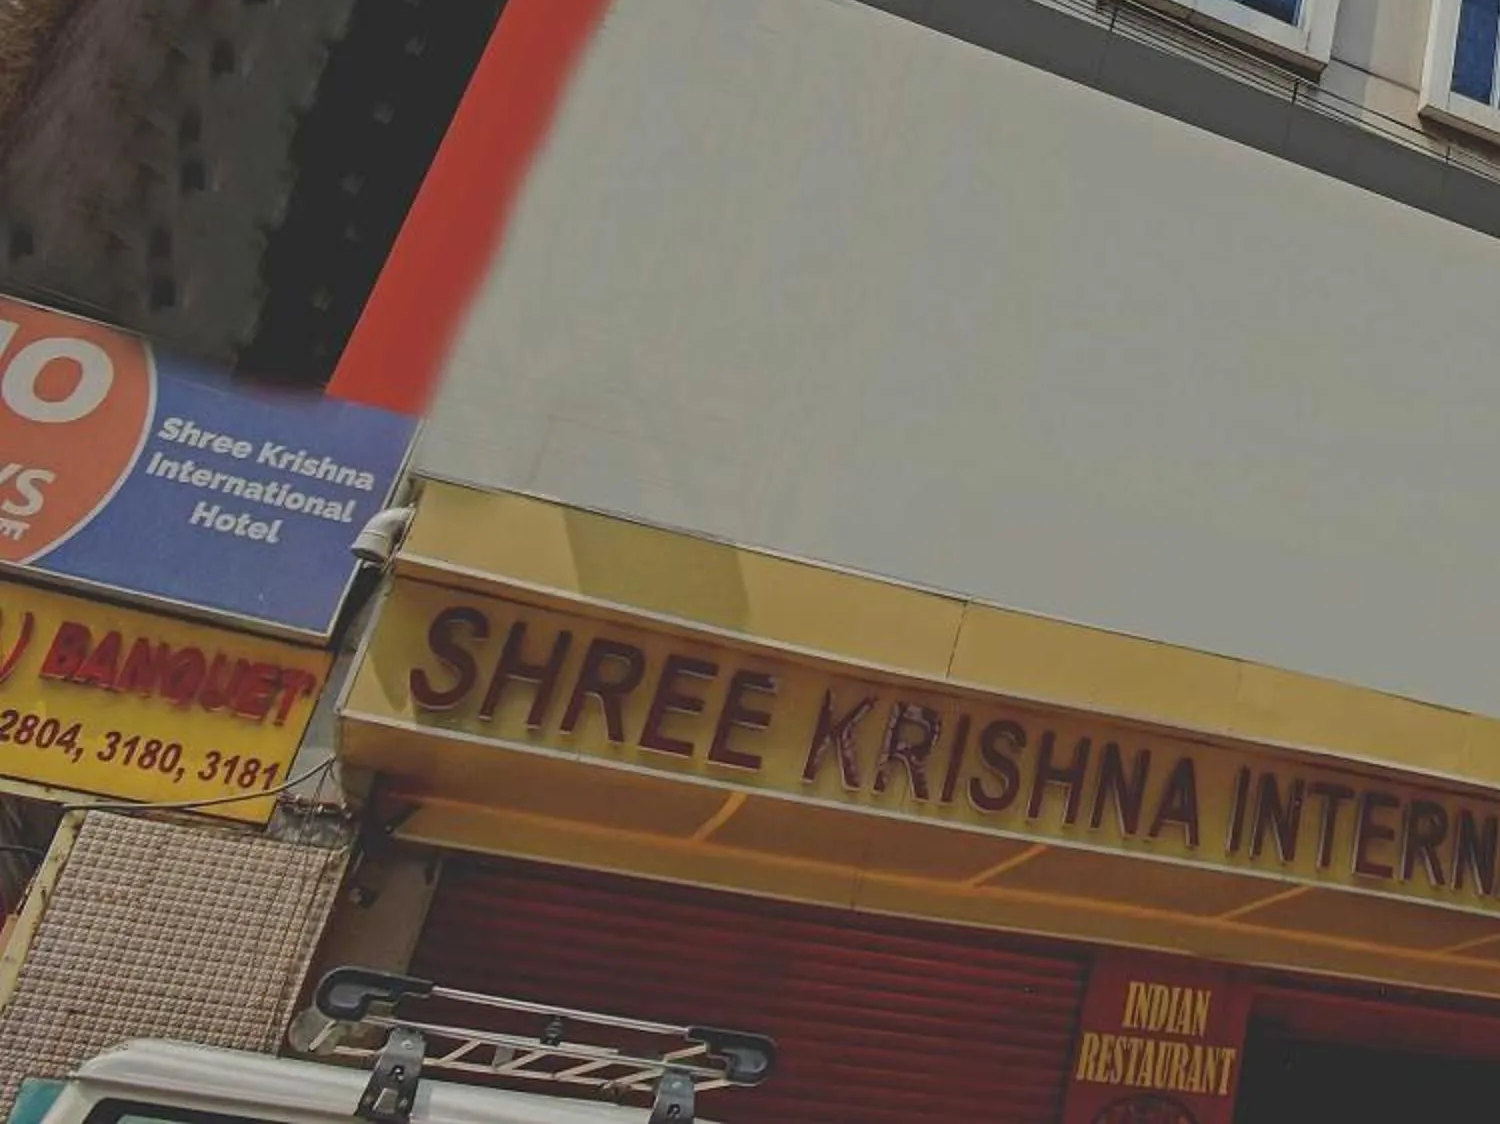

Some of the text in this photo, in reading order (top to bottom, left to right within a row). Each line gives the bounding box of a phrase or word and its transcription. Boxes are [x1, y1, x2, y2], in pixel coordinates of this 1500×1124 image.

[146, 452, 356, 523] International
[158, 417, 376, 491] Shree Krishna
[189, 501, 284, 543] Hotel
[39, 621, 317, 727] BANQUET
[97, 731, 184, 783] 3180,
[198, 751, 281, 790] 3181
[409, 605, 778, 771] SHREE
[801, 687, 1202, 851] KRISHNA
[1122, 981, 1212, 1037] INDIAN
[1075, 1031, 1238, 1097] RESTAURANT
